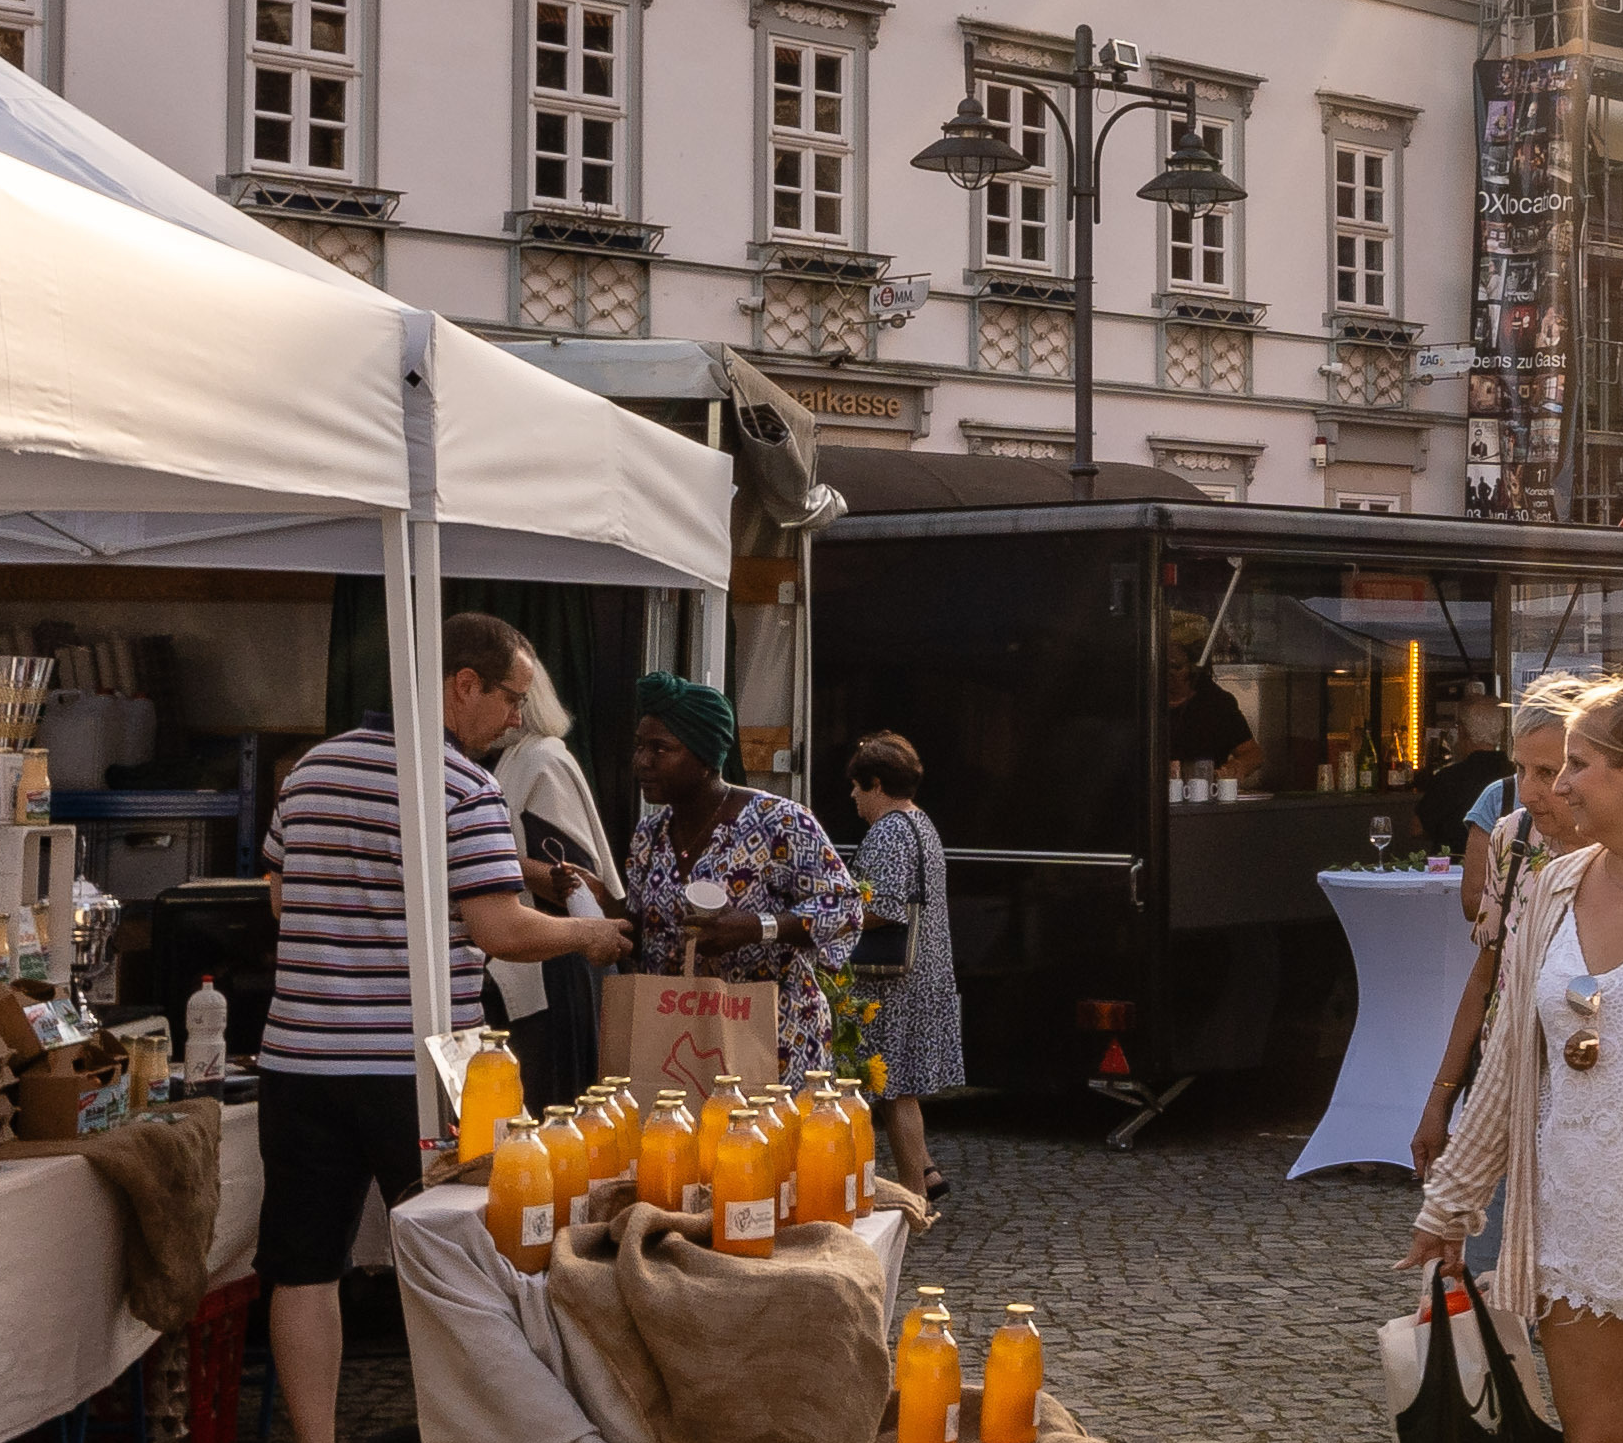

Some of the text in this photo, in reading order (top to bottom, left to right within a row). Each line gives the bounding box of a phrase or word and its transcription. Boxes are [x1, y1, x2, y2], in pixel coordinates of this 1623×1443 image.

[1419, 354, 1440, 367] ZAG
[1535, 352, 1568, 369] Gast
[657, 989, 752, 1021] SCHUH
